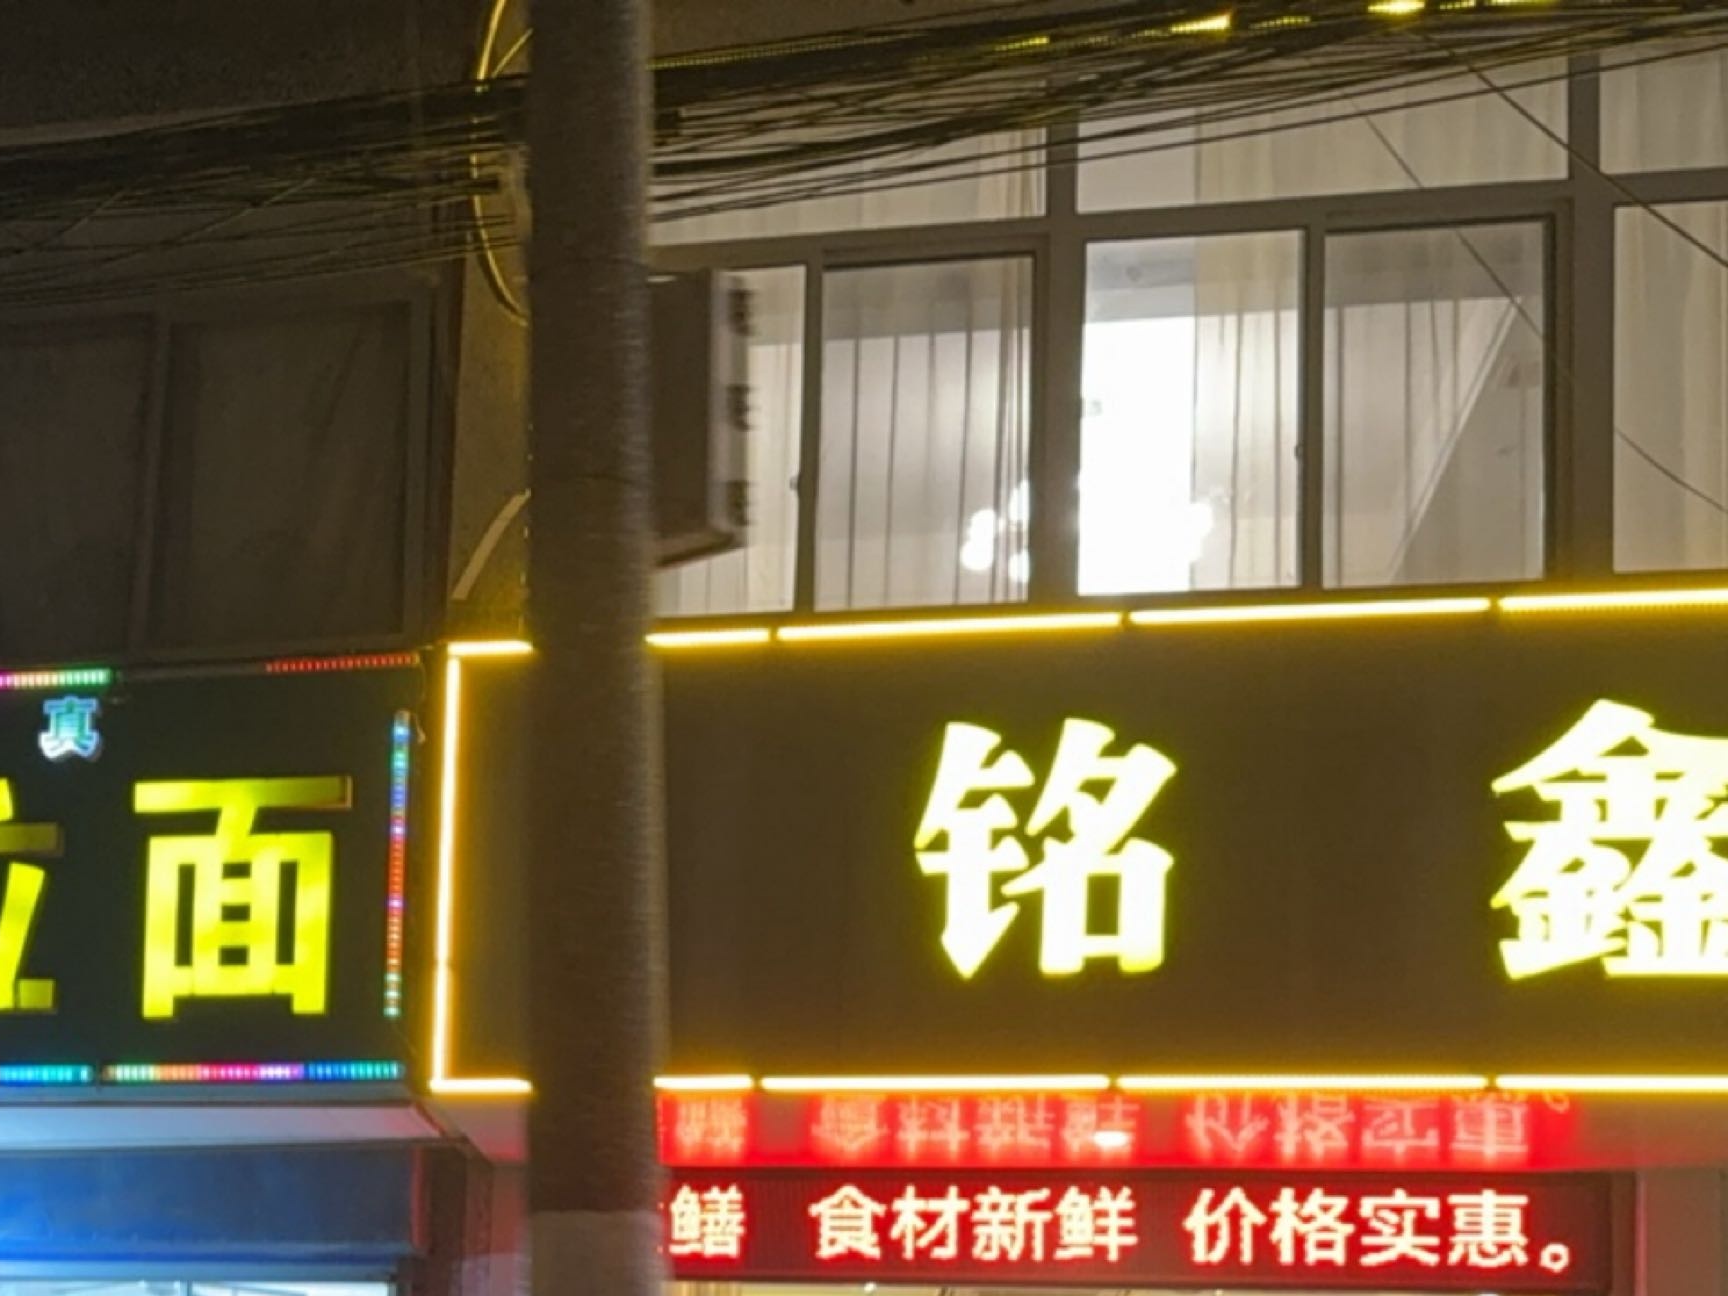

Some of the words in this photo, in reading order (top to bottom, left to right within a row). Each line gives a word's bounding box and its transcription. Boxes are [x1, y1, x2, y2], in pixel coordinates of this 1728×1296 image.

[914, 698, 1728, 982] 铭鑫
[669, 1185, 745, 1258] 鳝
[808, 1185, 1138, 1262] 食材新鲜
[1182, 1187, 1570, 1273] 价格实惠。
